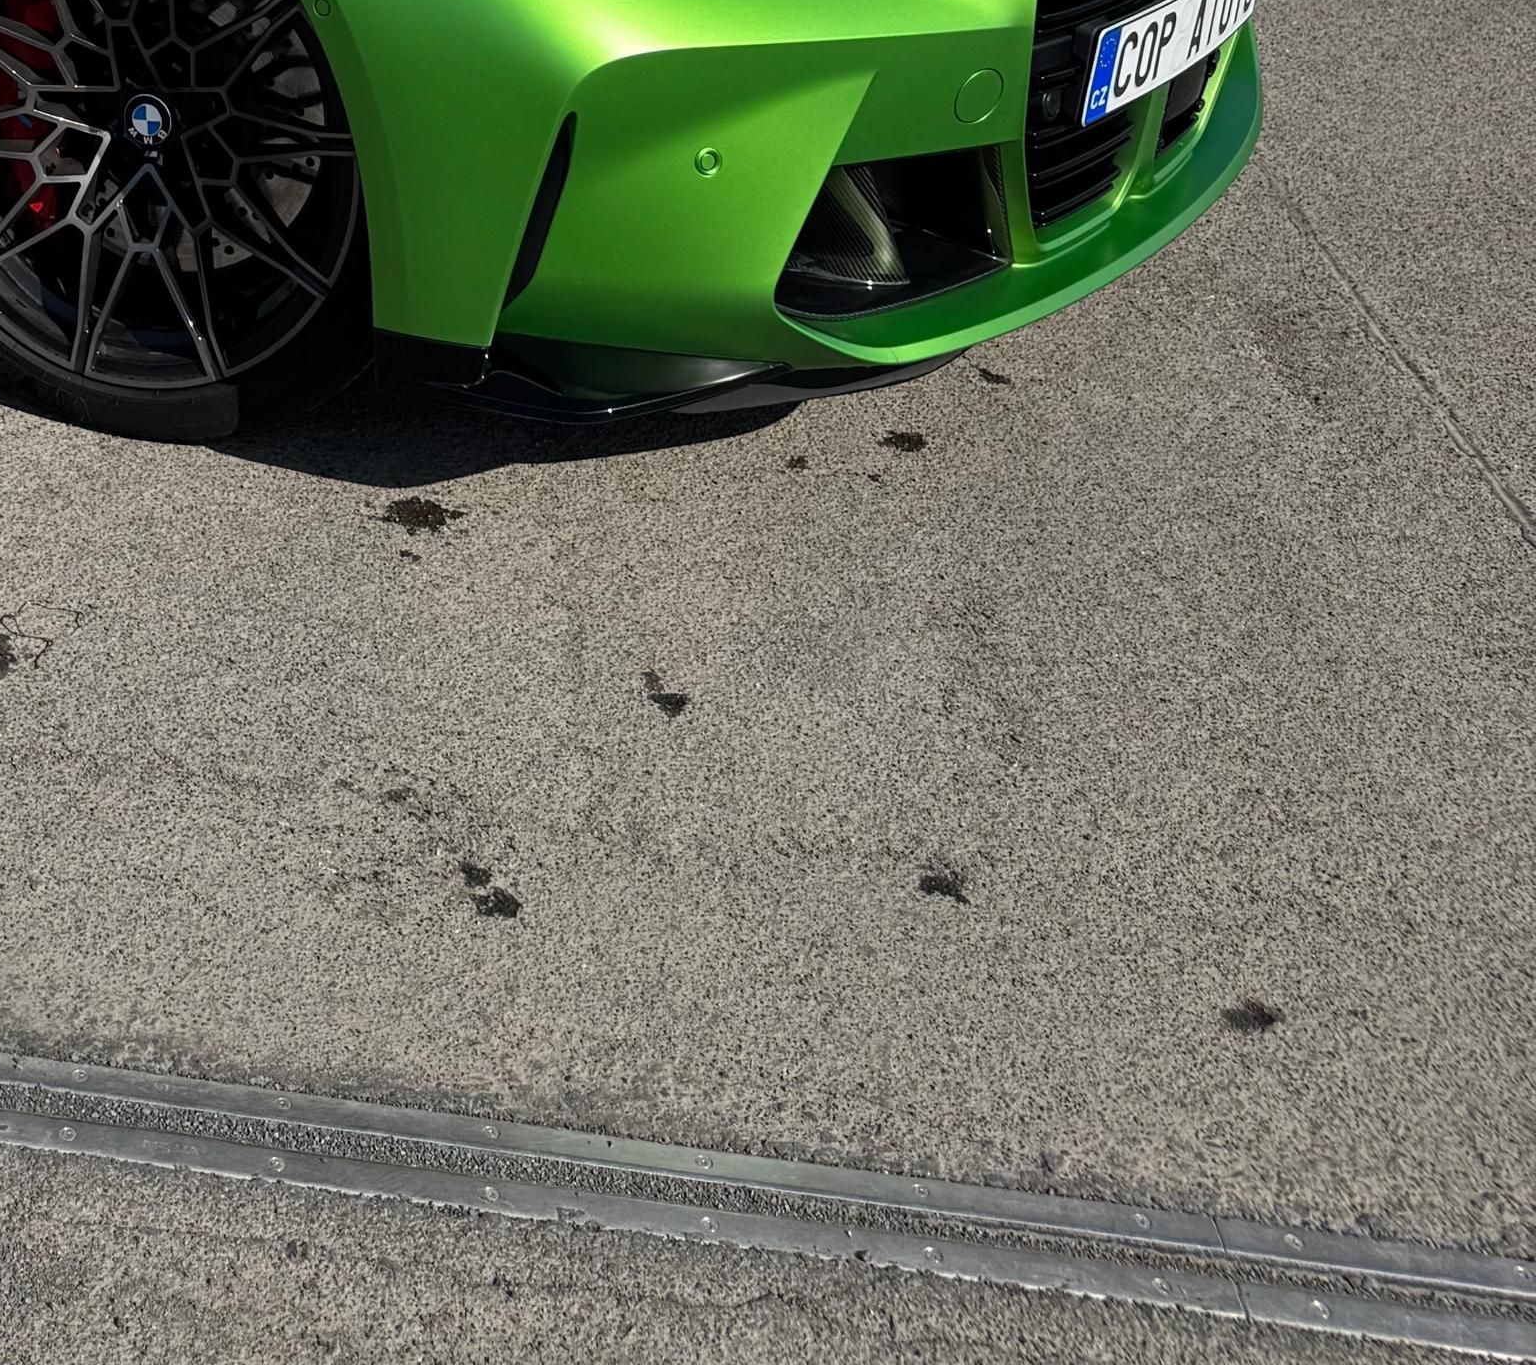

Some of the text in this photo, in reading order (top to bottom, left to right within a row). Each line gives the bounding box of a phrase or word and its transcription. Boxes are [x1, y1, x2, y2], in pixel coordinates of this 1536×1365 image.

[1090, 85, 1109, 110] CZ
[1113, 11, 1177, 98] COP
[128, 127, 168, 145] BMW
